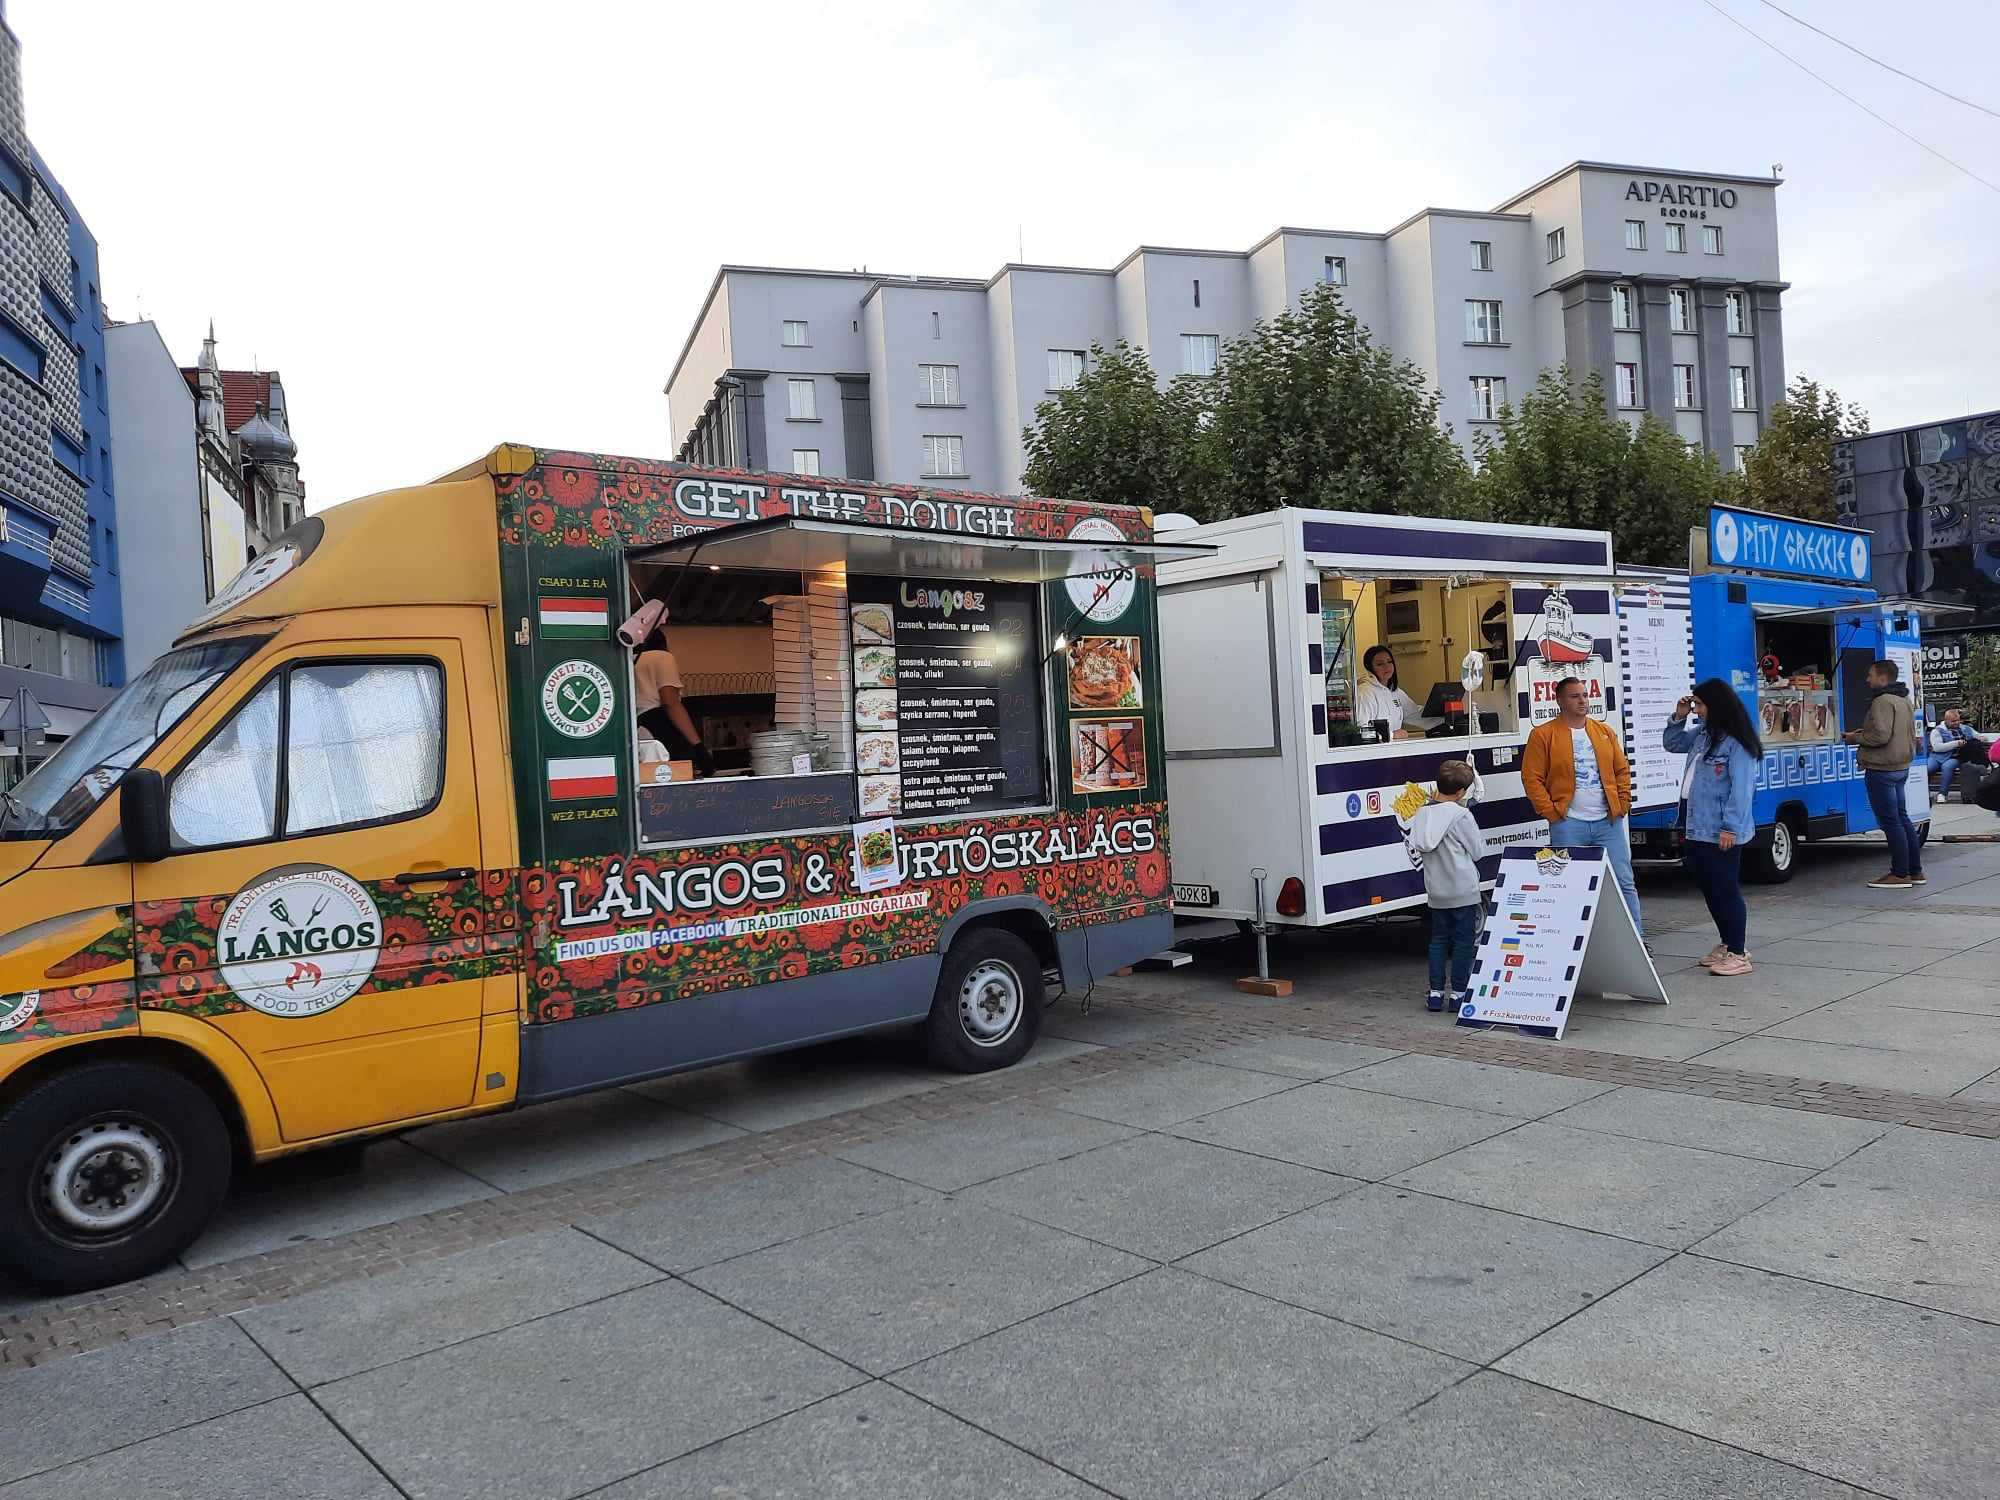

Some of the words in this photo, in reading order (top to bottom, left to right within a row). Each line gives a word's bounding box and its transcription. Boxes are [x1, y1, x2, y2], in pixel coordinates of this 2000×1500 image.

[1625, 180, 1737, 208] APARTIO
[1660, 208, 1707, 220] ROOMS
[674, 480, 766, 520] GET
[781, 488, 866, 519] THE
[881, 497, 1015, 537] DOUGH
[1742, 521, 1779, 566] PITY
[1783, 528, 1847, 574] GRECKIE
[576, 578, 591, 588] LE
[900, 581, 986, 618] Langosz
[546, 667, 566, 693] LOVE
[924, 669, 944, 679] oliwki
[1923, 660, 1960, 670] AKFAST
[1533, 678, 1602, 702] FISA
[577, 808, 618, 820] PLACKA
[558, 857, 787, 928] LÁNGOS
[805, 853, 834, 893] &
[849, 814, 1155, 888] RTŐSKALÁCS
[305, 872, 373, 916] HUNGARIAN
[224, 921, 376, 963] LÁNGOS
[559, 941, 597, 960] FIND
[600, 937, 620, 953] US
[623, 935, 646, 951] ON
[651, 923, 726, 946] FACEBOOK
[253, 992, 299, 1013] FOOD
[303, 980, 357, 1011] TRUCK
